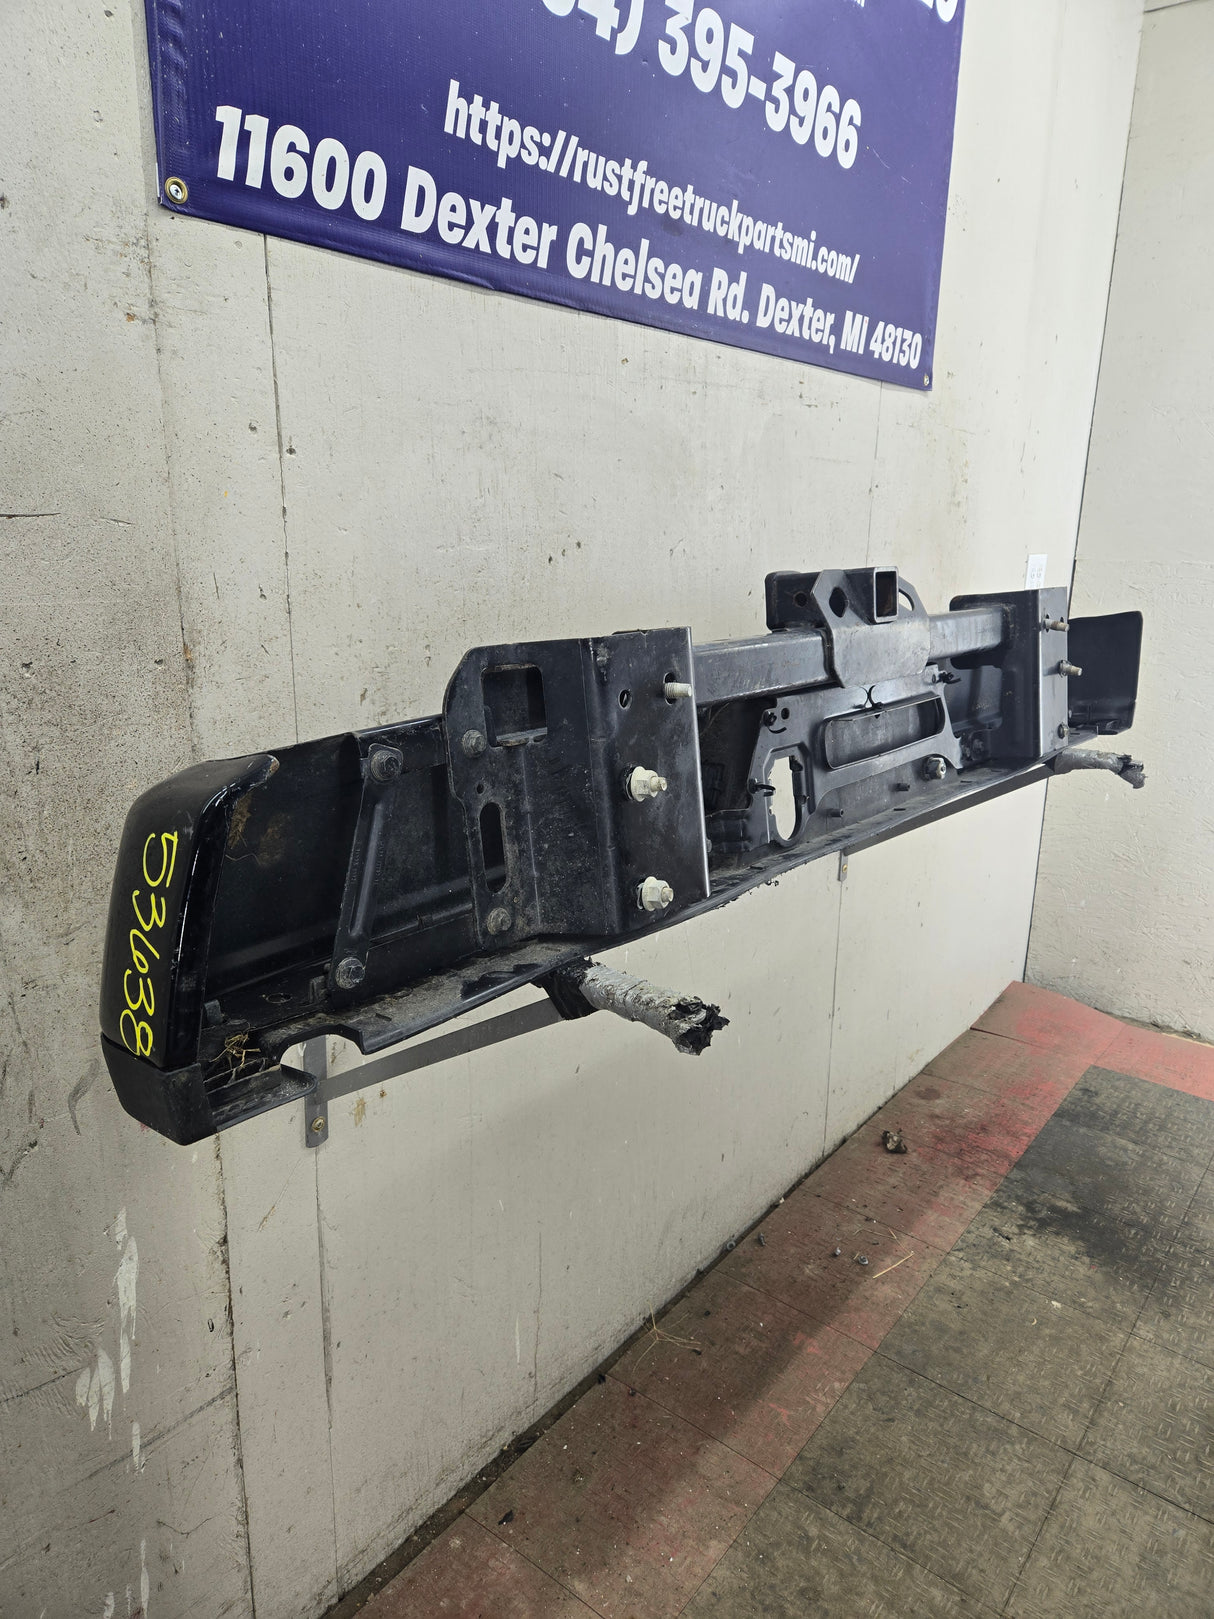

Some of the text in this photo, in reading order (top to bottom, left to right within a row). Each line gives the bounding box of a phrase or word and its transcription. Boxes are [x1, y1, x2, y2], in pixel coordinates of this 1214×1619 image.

[443, 78, 861, 285] https://rustfreetruckpartsmi.com/
[542, 0, 862, 170] 4) 395-3966
[215, 105, 923, 370] 11600 Dexter Chelsea Rd. Dexter, MI 48130
[119, 831, 179, 1057] 53638
